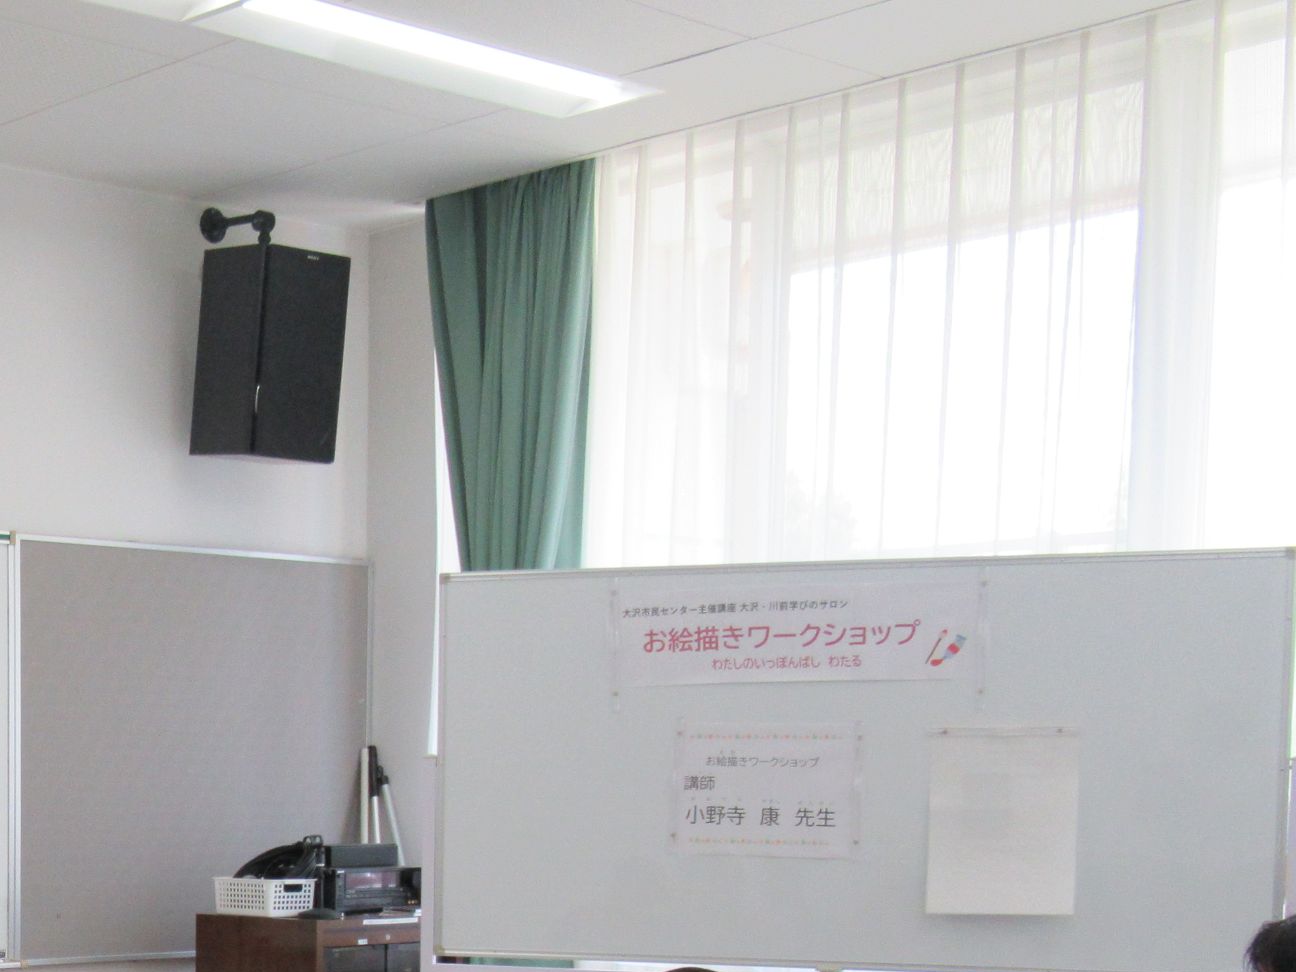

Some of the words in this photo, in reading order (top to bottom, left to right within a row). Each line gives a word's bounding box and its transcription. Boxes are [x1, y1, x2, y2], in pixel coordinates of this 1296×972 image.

[643, 618, 921, 653] お絵描きワークショップ
[828, 655, 862, 668] わたる
[684, 775, 716, 790] 講師
[685, 805, 746, 826] 小野寺
[760, 806, 780, 826] 康
[795, 807, 836, 827] 先生
